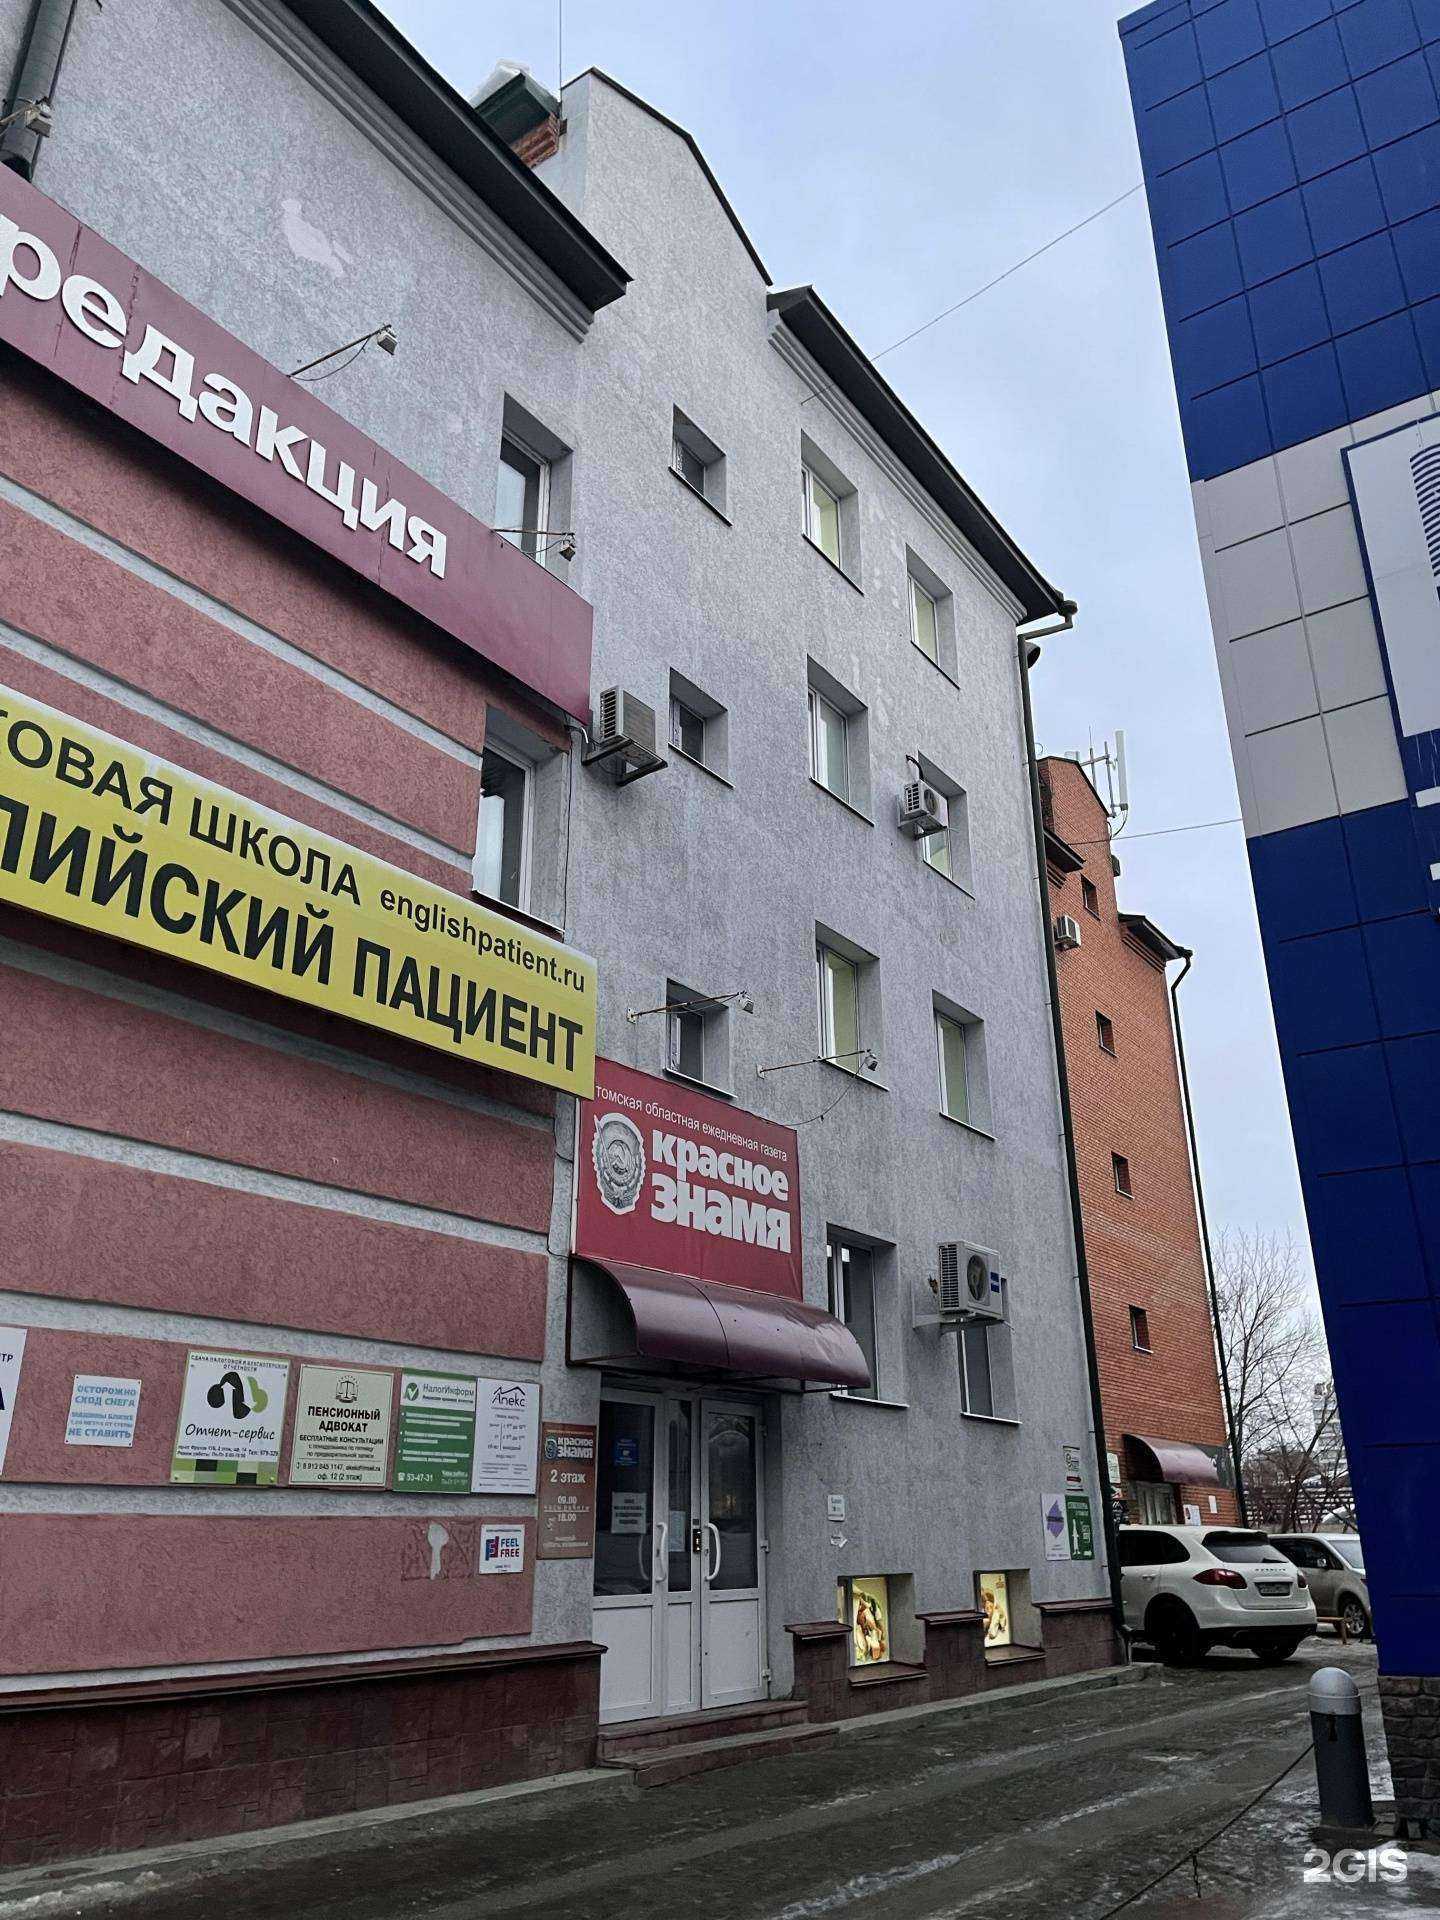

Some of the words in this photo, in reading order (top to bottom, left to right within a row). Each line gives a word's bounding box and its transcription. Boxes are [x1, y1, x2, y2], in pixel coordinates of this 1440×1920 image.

[0, 213, 447, 580] редакция
[0, 709, 173, 826] ОВАЯ
[189, 797, 361, 906] ШКОЛА
[380, 889, 585, 993] englishpatient.ru
[352, 937, 583, 1073] ПАЦИЕНТ
[595, 1085, 642, 1112] томская
[645, 1102, 700, 1131] областная
[702, 1122, 759, 1152] ежедневная
[760, 1143, 787, 1162] газета
[652, 1129, 789, 1202] красное
[650, 1173, 792, 1254] знамя
[77, 1385, 137, 1397] ОСТОРОЖНО
[75, 1395, 102, 1407] СХОД
[104, 1397, 136, 1408] СНЕГА
[491, 1393, 526, 1408] Апекс
[307, 1405, 381, 1421] ПЕНСИОННЫЙ
[68, 1427, 82, 1438] НЕ
[84, 1428, 132, 1439] СТАВИТЬ
[185, 1423, 276, 1443] Отчет-сервис
[318, 1420, 369, 1433] АДВОКАТ
[299, 1434, 339, 1443] БЕСПЛАТНЫЕ
[339, 1436, 384, 1446] КОНСУЛЬТАЦИИ
[557, 1436, 594, 1448] красное
[557, 1446, 594, 1459] знамя
[550, 1469, 558, 1483] 2
[560, 1472, 586, 1484] этаж
[500, 1537, 520, 1548] FEEL
[500, 1548, 520, 1559] FREE
